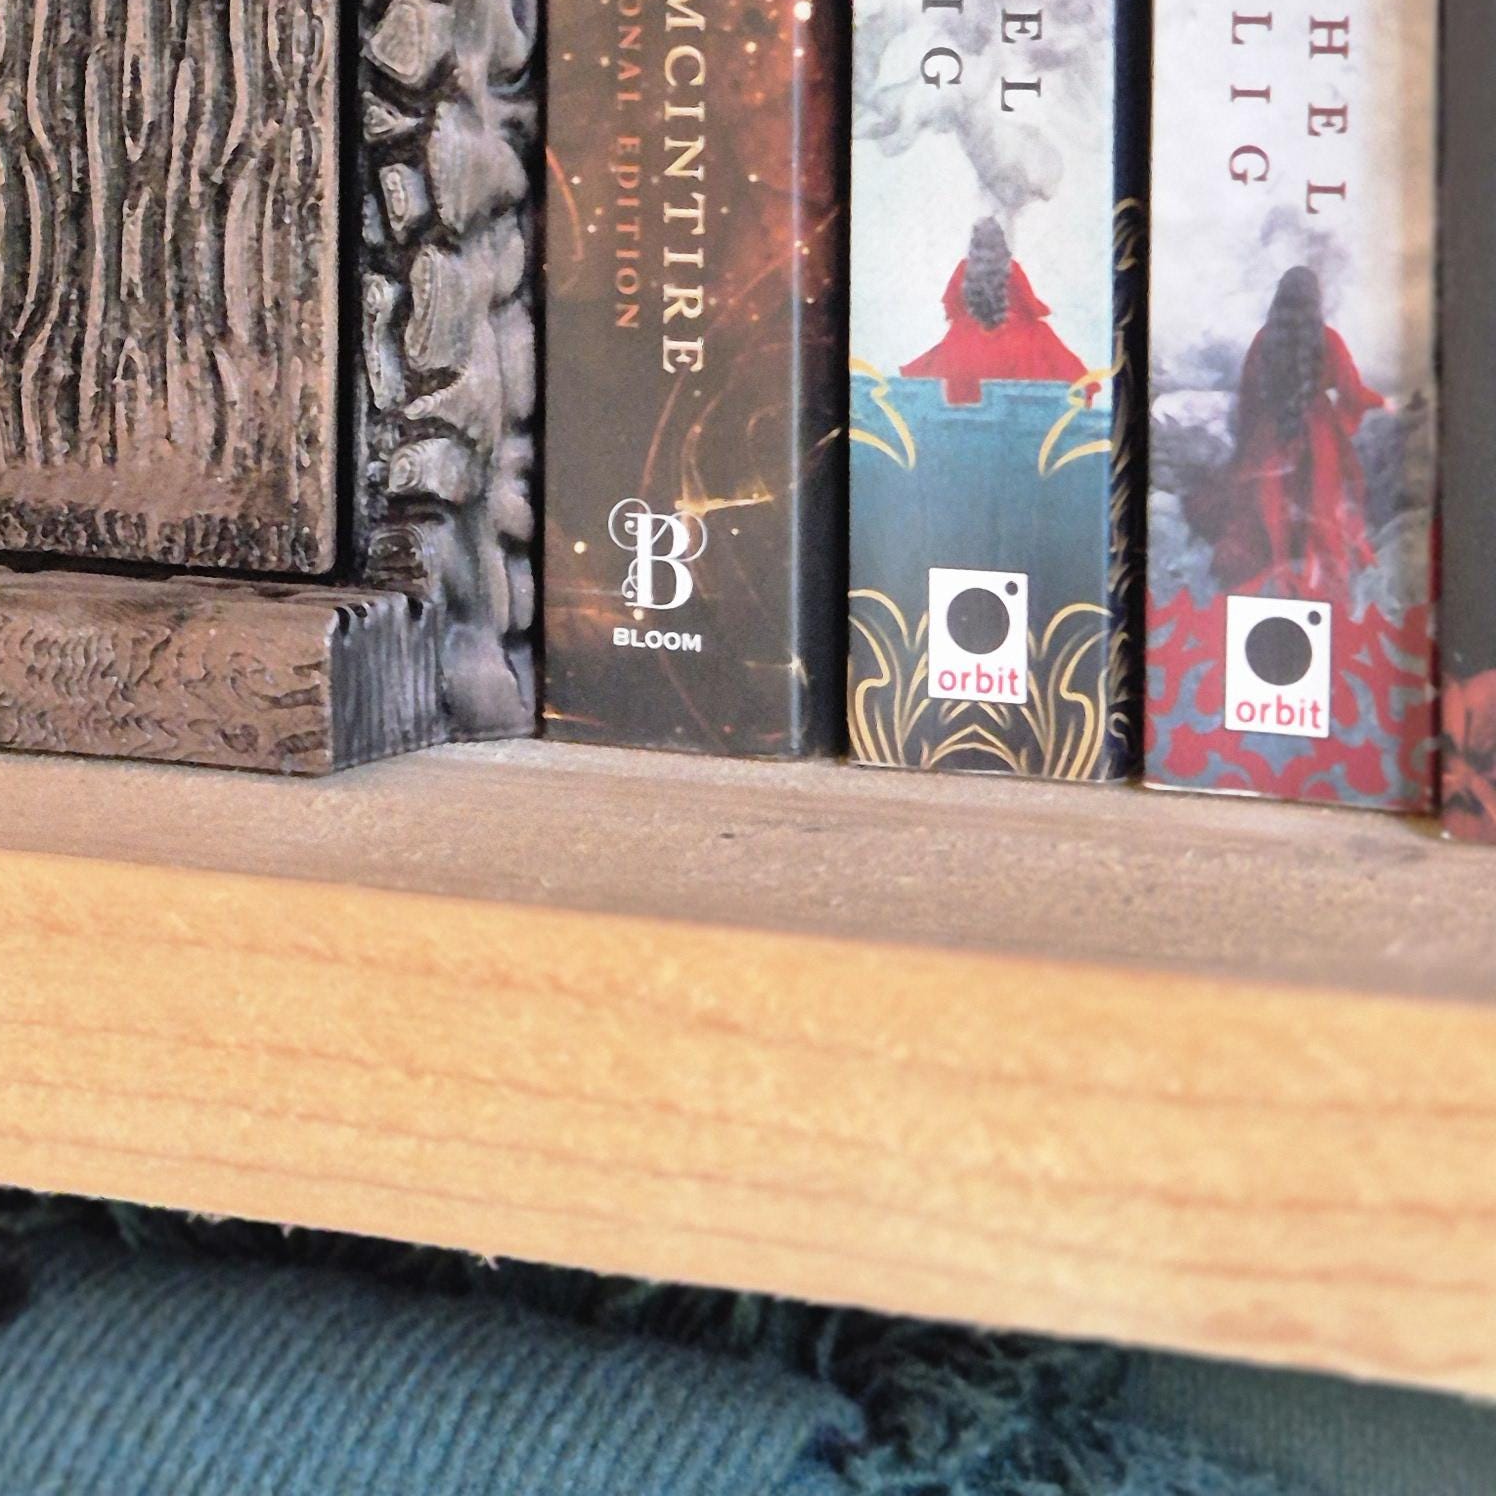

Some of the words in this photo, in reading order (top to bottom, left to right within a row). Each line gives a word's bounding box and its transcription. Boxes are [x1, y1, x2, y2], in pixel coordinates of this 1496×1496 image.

[614, 133, 641, 330] EDITION
[608, 498, 707, 609] B
[613, 627, 702, 652] BLOOM
[938, 663, 1020, 696] orbit
[1235, 694, 1322, 730] orbit
